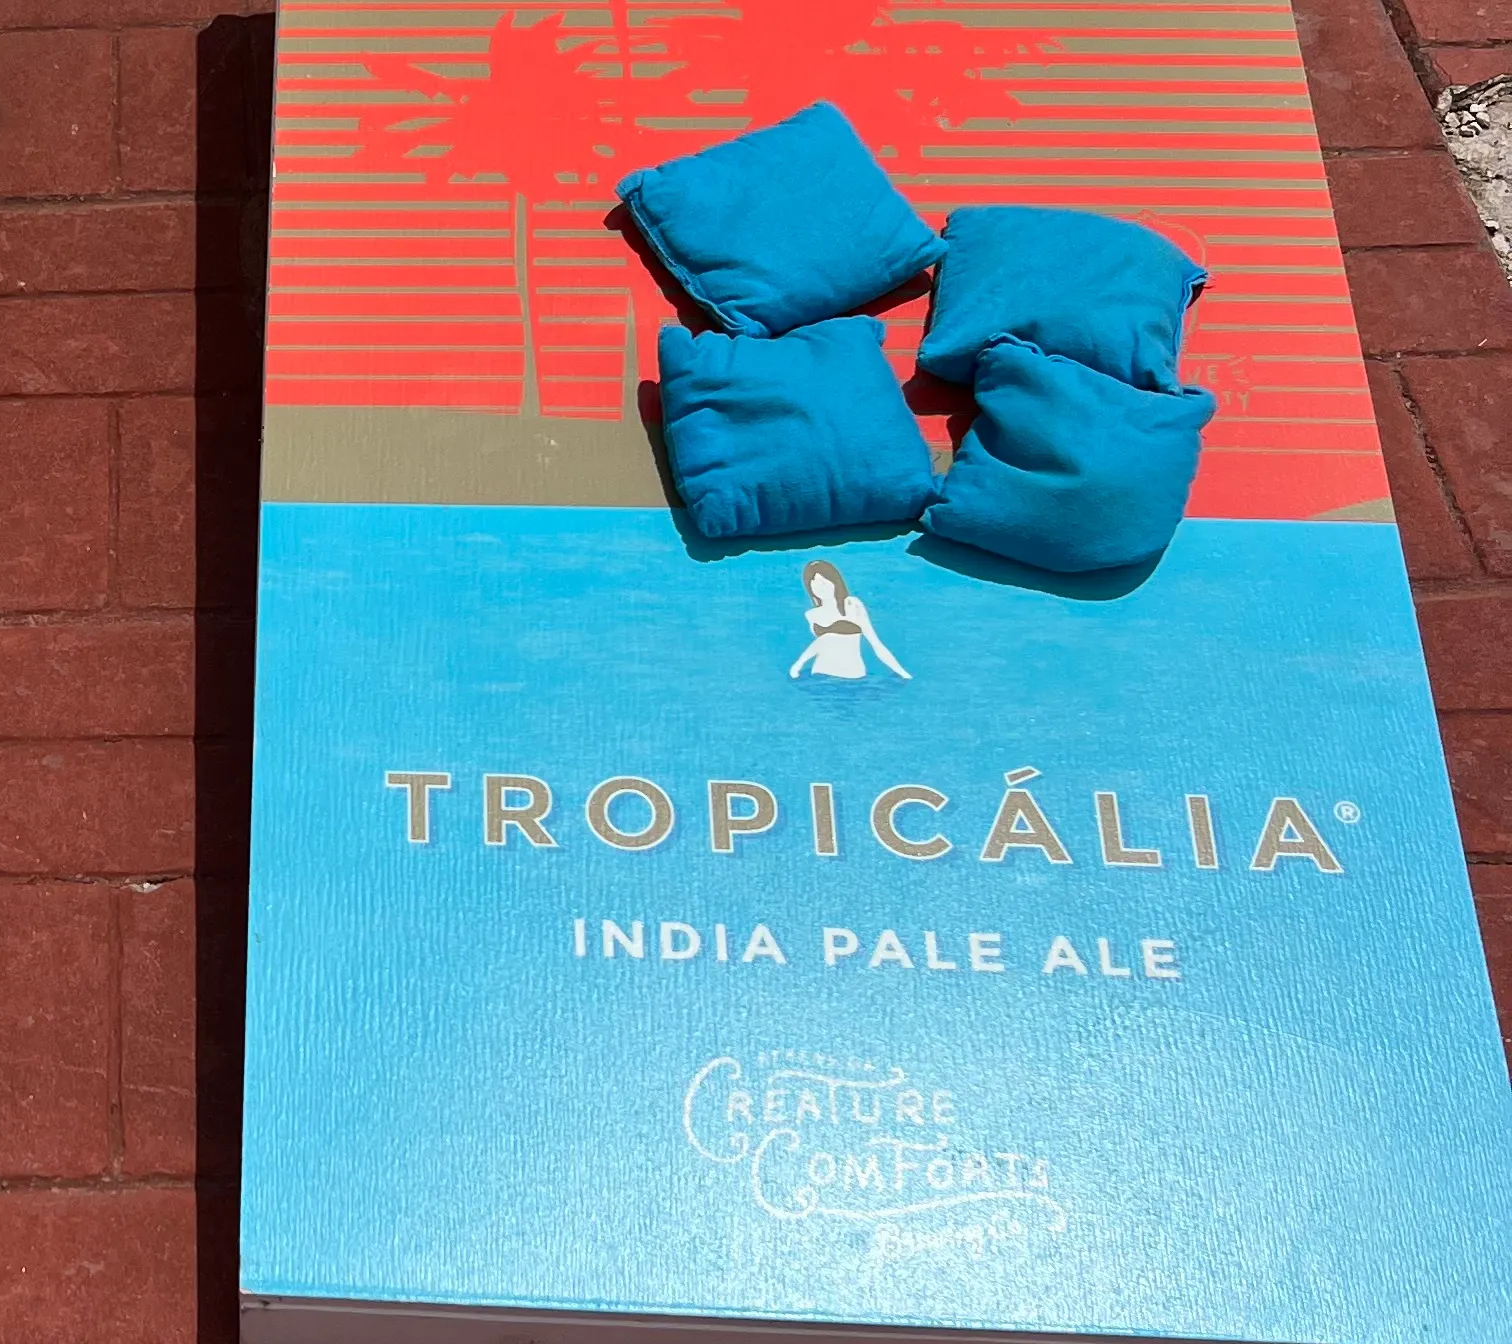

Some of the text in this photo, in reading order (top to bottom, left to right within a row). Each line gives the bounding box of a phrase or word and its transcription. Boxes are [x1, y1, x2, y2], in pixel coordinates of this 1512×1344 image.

[572, 918, 1183, 980] INDIA PALE ALE
